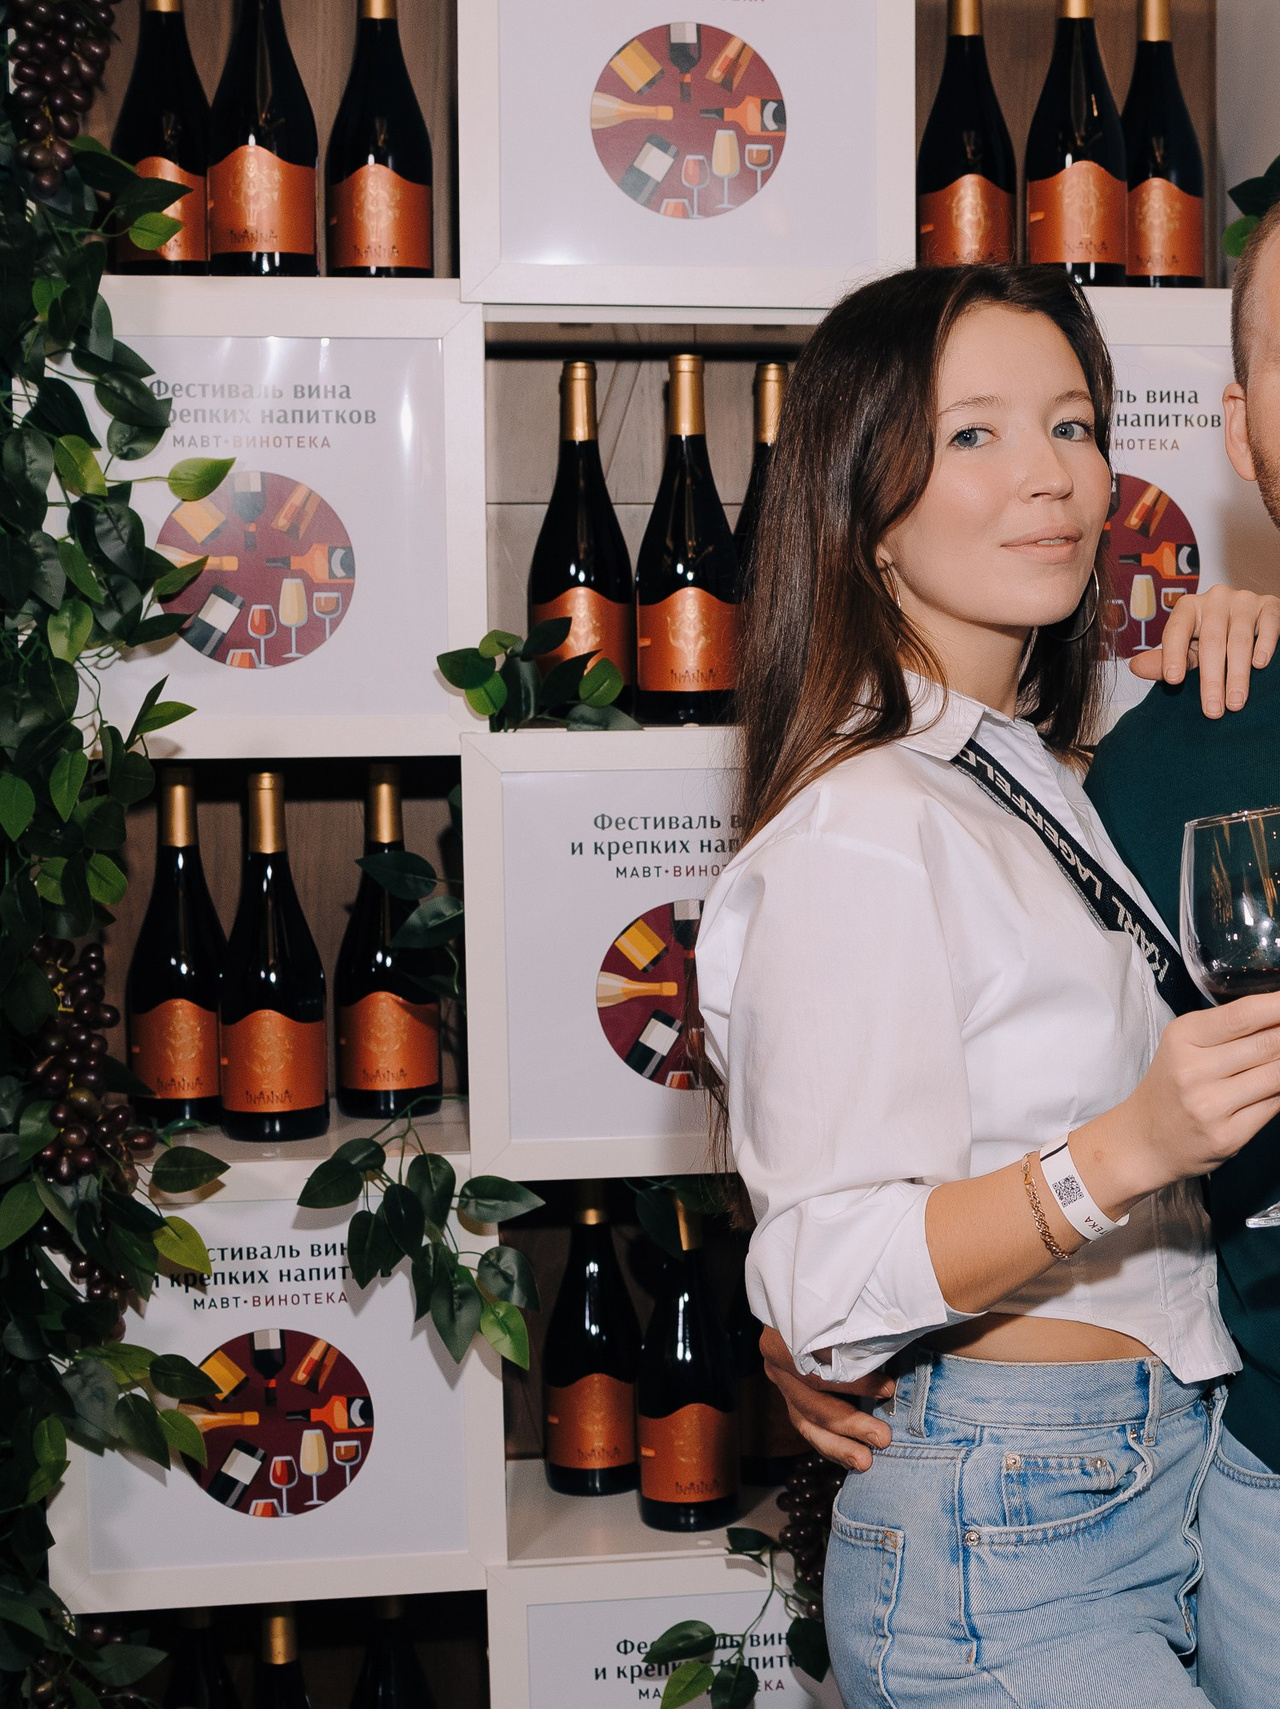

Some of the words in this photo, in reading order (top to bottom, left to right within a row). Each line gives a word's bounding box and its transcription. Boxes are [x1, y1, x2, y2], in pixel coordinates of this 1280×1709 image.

[149, 379, 284, 400] Фестиваль
[293, 383, 352, 400] вина
[1146, 389, 1199, 404] вина
[260, 408, 377, 425] напитков
[1116, 412, 1222, 428] напитков
[593, 813, 722, 831] Фестиваль
[570, 841, 584, 856] и
[593, 838, 691, 861] крепких
[1111, 895, 1170, 983] KARL
[310, 1242, 349, 1258] вин
[169, 1270, 270, 1294] крепких
[749, 1633, 787, 1648] вин
[594, 1666, 607, 1681] и
